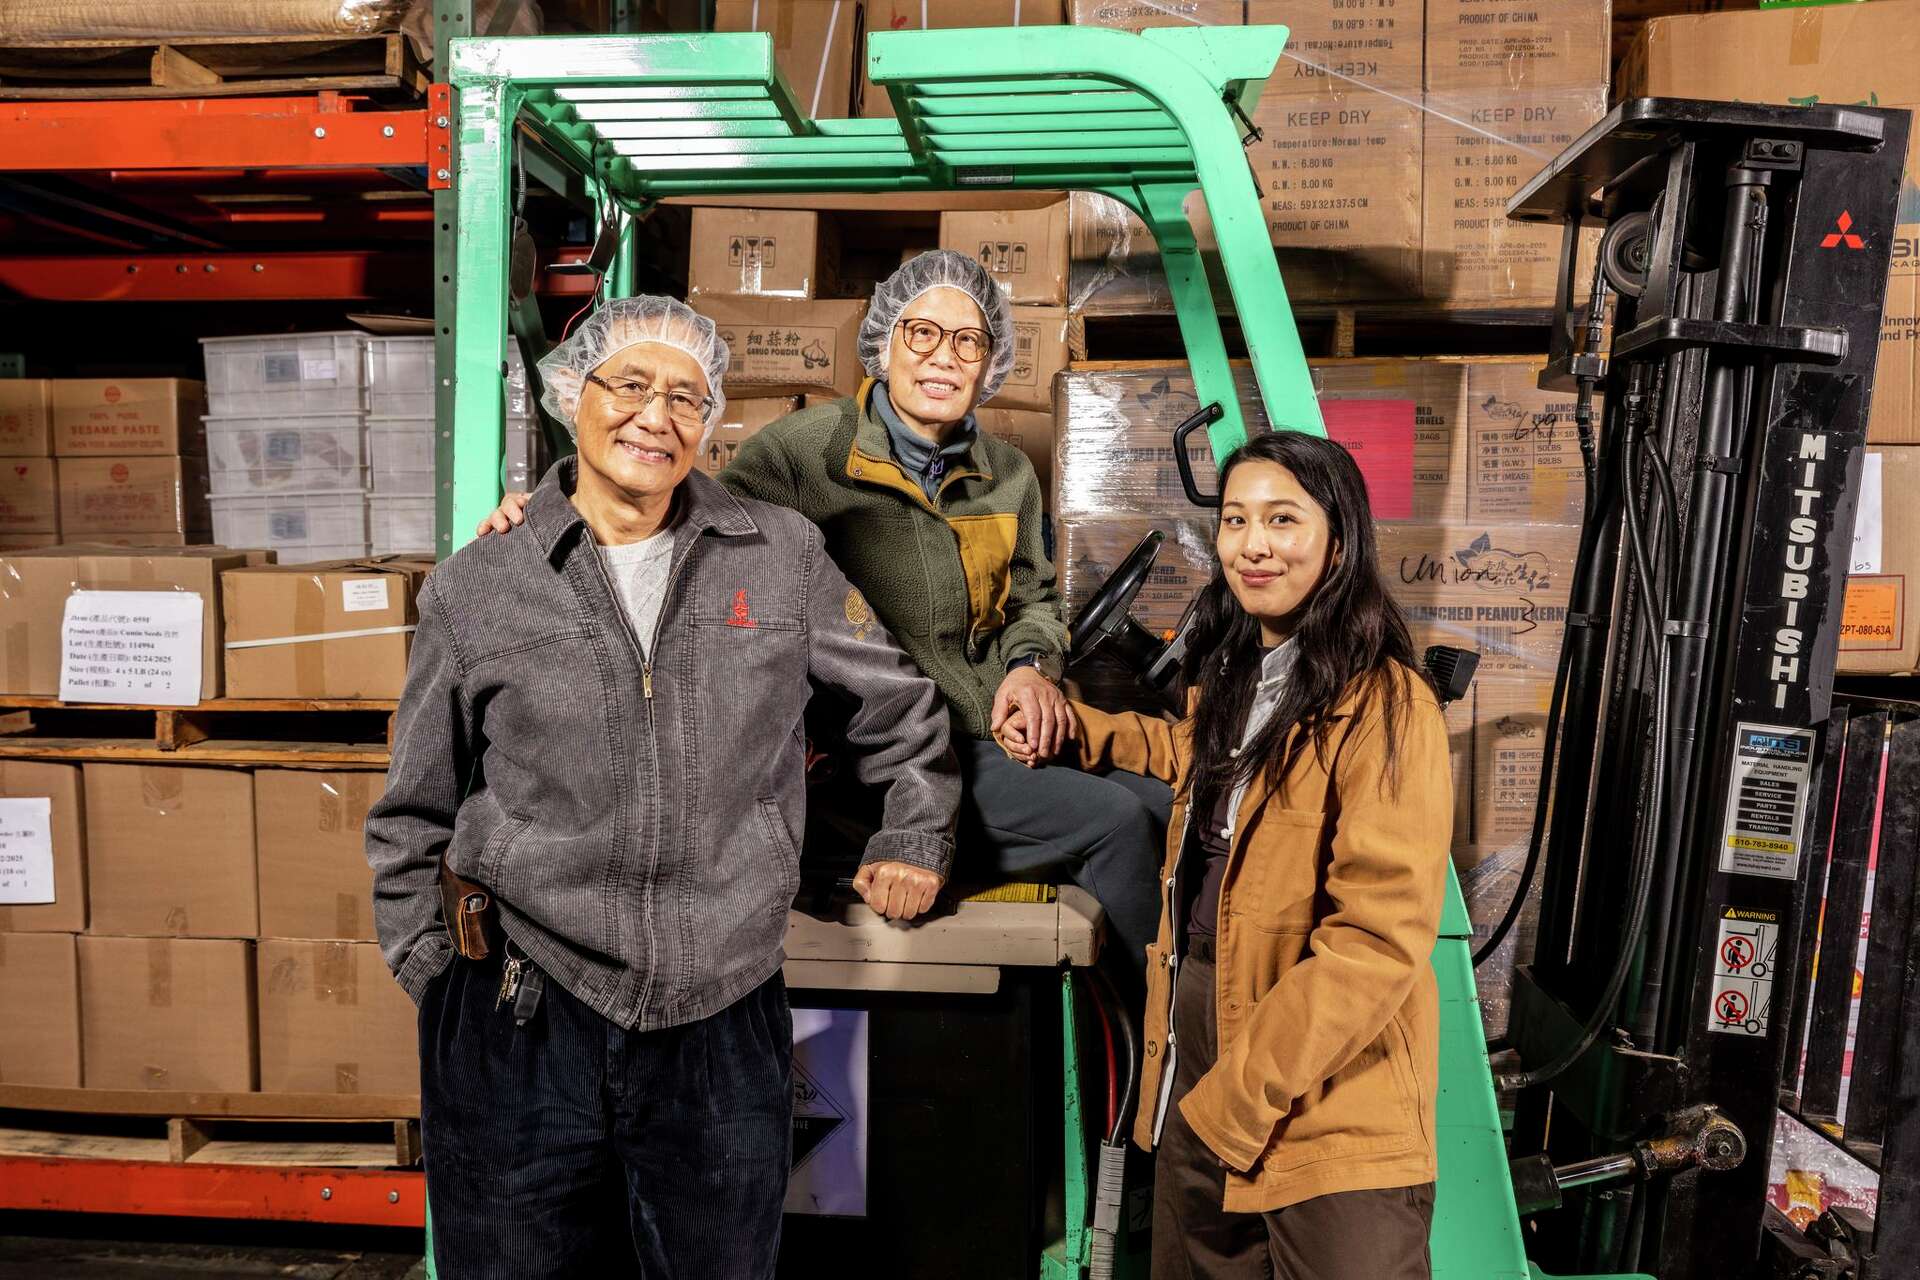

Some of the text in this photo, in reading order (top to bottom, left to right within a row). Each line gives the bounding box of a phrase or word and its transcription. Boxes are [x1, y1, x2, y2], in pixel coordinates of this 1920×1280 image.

[1459, 11, 1539, 25] PRODUCT OF CHINA
[1294, 62, 1377, 78] KEEP DRY
[1288, 109, 1372, 127] KEEP DRY
[1471, 106, 1557, 123] KEEP DRY
[1366, 136, 1386, 146] temp
[1551, 134, 1572, 145] temp
[1322, 158, 1333, 168] KG
[1506, 155, 1517, 165] KG
[1322, 178, 1333, 188] KG
[1506, 176, 1517, 186] KG
[1272, 200, 1297, 211] MEAS:
[1454, 197, 1511, 209] MEAS: 59X3
[1272, 220, 1349, 232] PRODUCT OF CHINA
[1454, 218, 1490, 230] PRODUCT
[1493, 218, 1504, 229] OF
[771, 348, 799, 356] POWDER
[71, 425, 161, 435] SESAME PASTE
[1420, 432, 1440, 440] BAGS
[1399, 553, 1498, 585] Union
[1770, 434, 1827, 708] MITSUBISHI
[1476, 606, 1525, 621] PEANUT
[68, 627, 95, 635] Product
[120, 629, 143, 637] Cumin
[69, 652, 87, 660] Date
[69, 665, 84, 673] Size
[134, 668, 146, 676] LB
[1742, 761, 1803, 772] MATERIAL HANDLING
[1754, 769, 1788, 777] EQUIPMENT
[1759, 780, 1780, 788] SALES
[1754, 791, 1782, 799] SERVICE
[1750, 813, 1779, 821] RENTALS
[1748, 824, 1780, 832] TRAINING
[1736, 910, 1776, 921] WARNING
